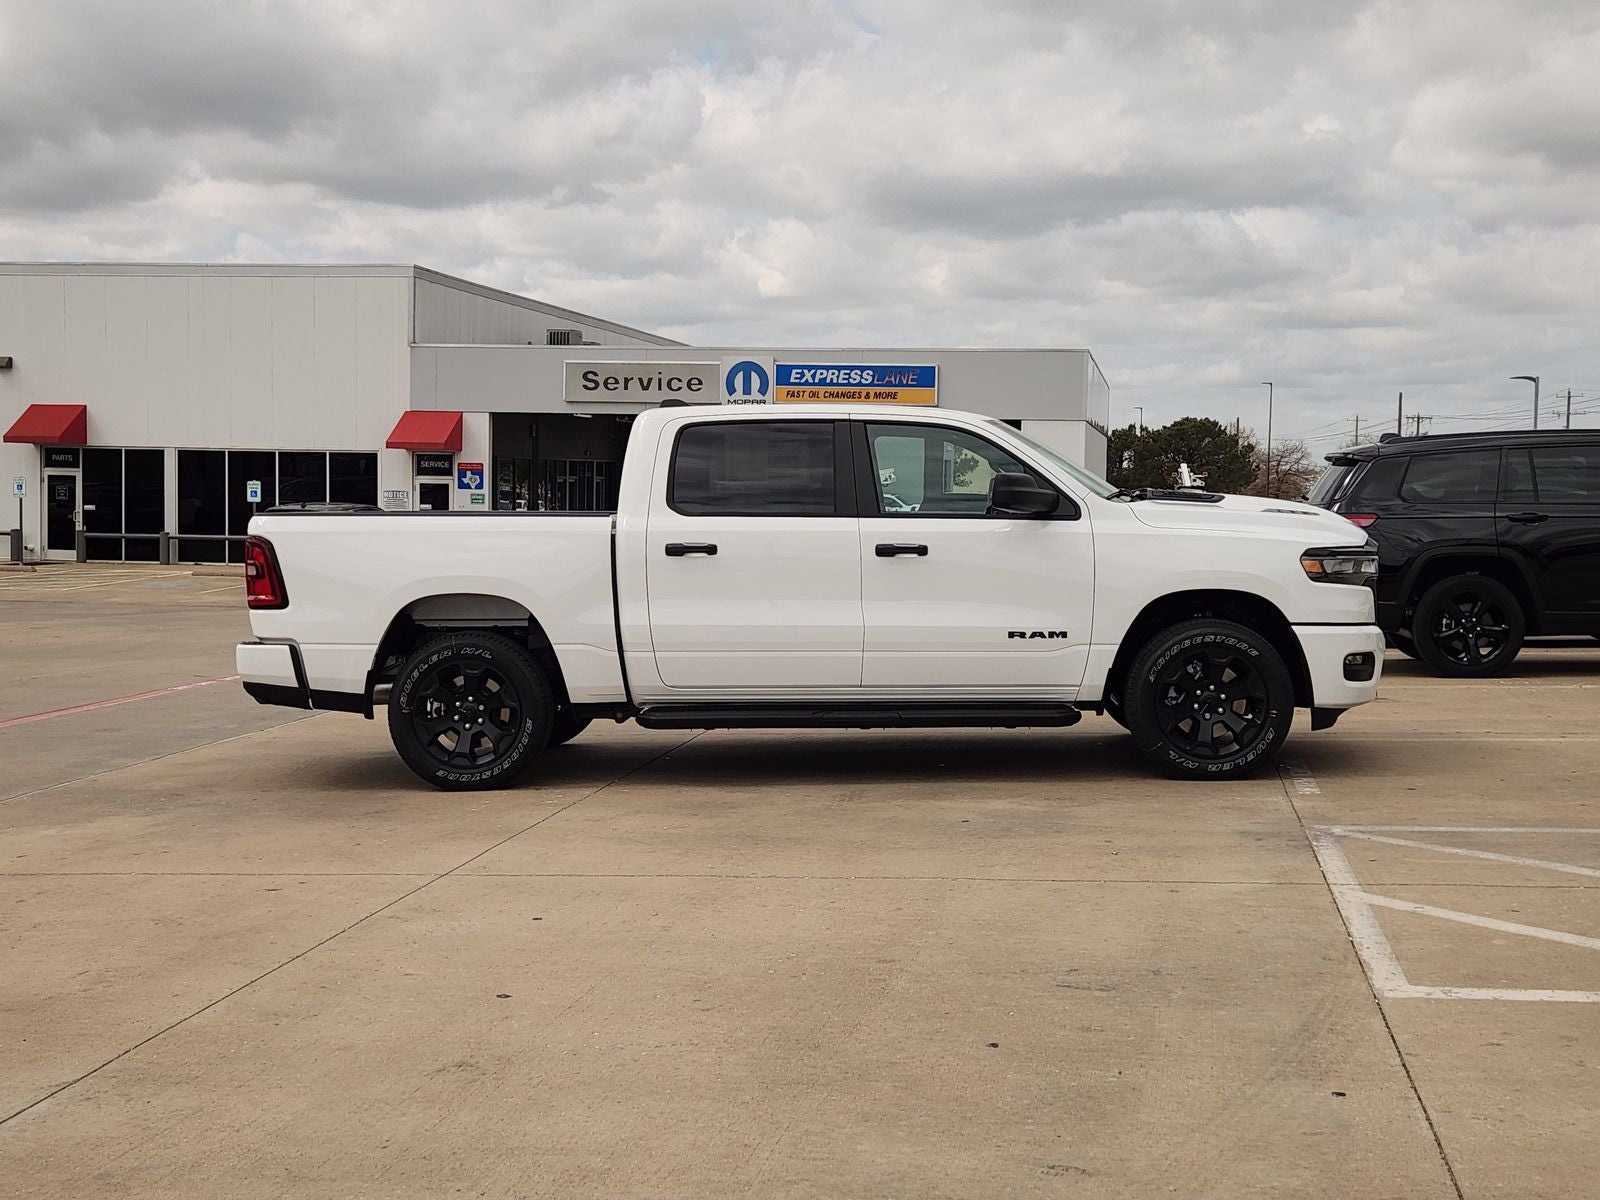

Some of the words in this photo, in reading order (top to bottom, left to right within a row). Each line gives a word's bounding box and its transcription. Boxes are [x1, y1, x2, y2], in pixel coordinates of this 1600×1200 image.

[582, 370, 704, 392] Service
[785, 390, 806, 398] FAST
[808, 391, 820, 399] OIL
[823, 391, 862, 399] CHANGES
[864, 391, 871, 399] &
[873, 391, 899, 400] MORE
[1007, 631, 1068, 639] RAM
[1148, 635, 1260, 683] BRIDGESTONE
[400, 649, 452, 708] DUELER
[435, 717, 533, 782] BRIDGESTONE
